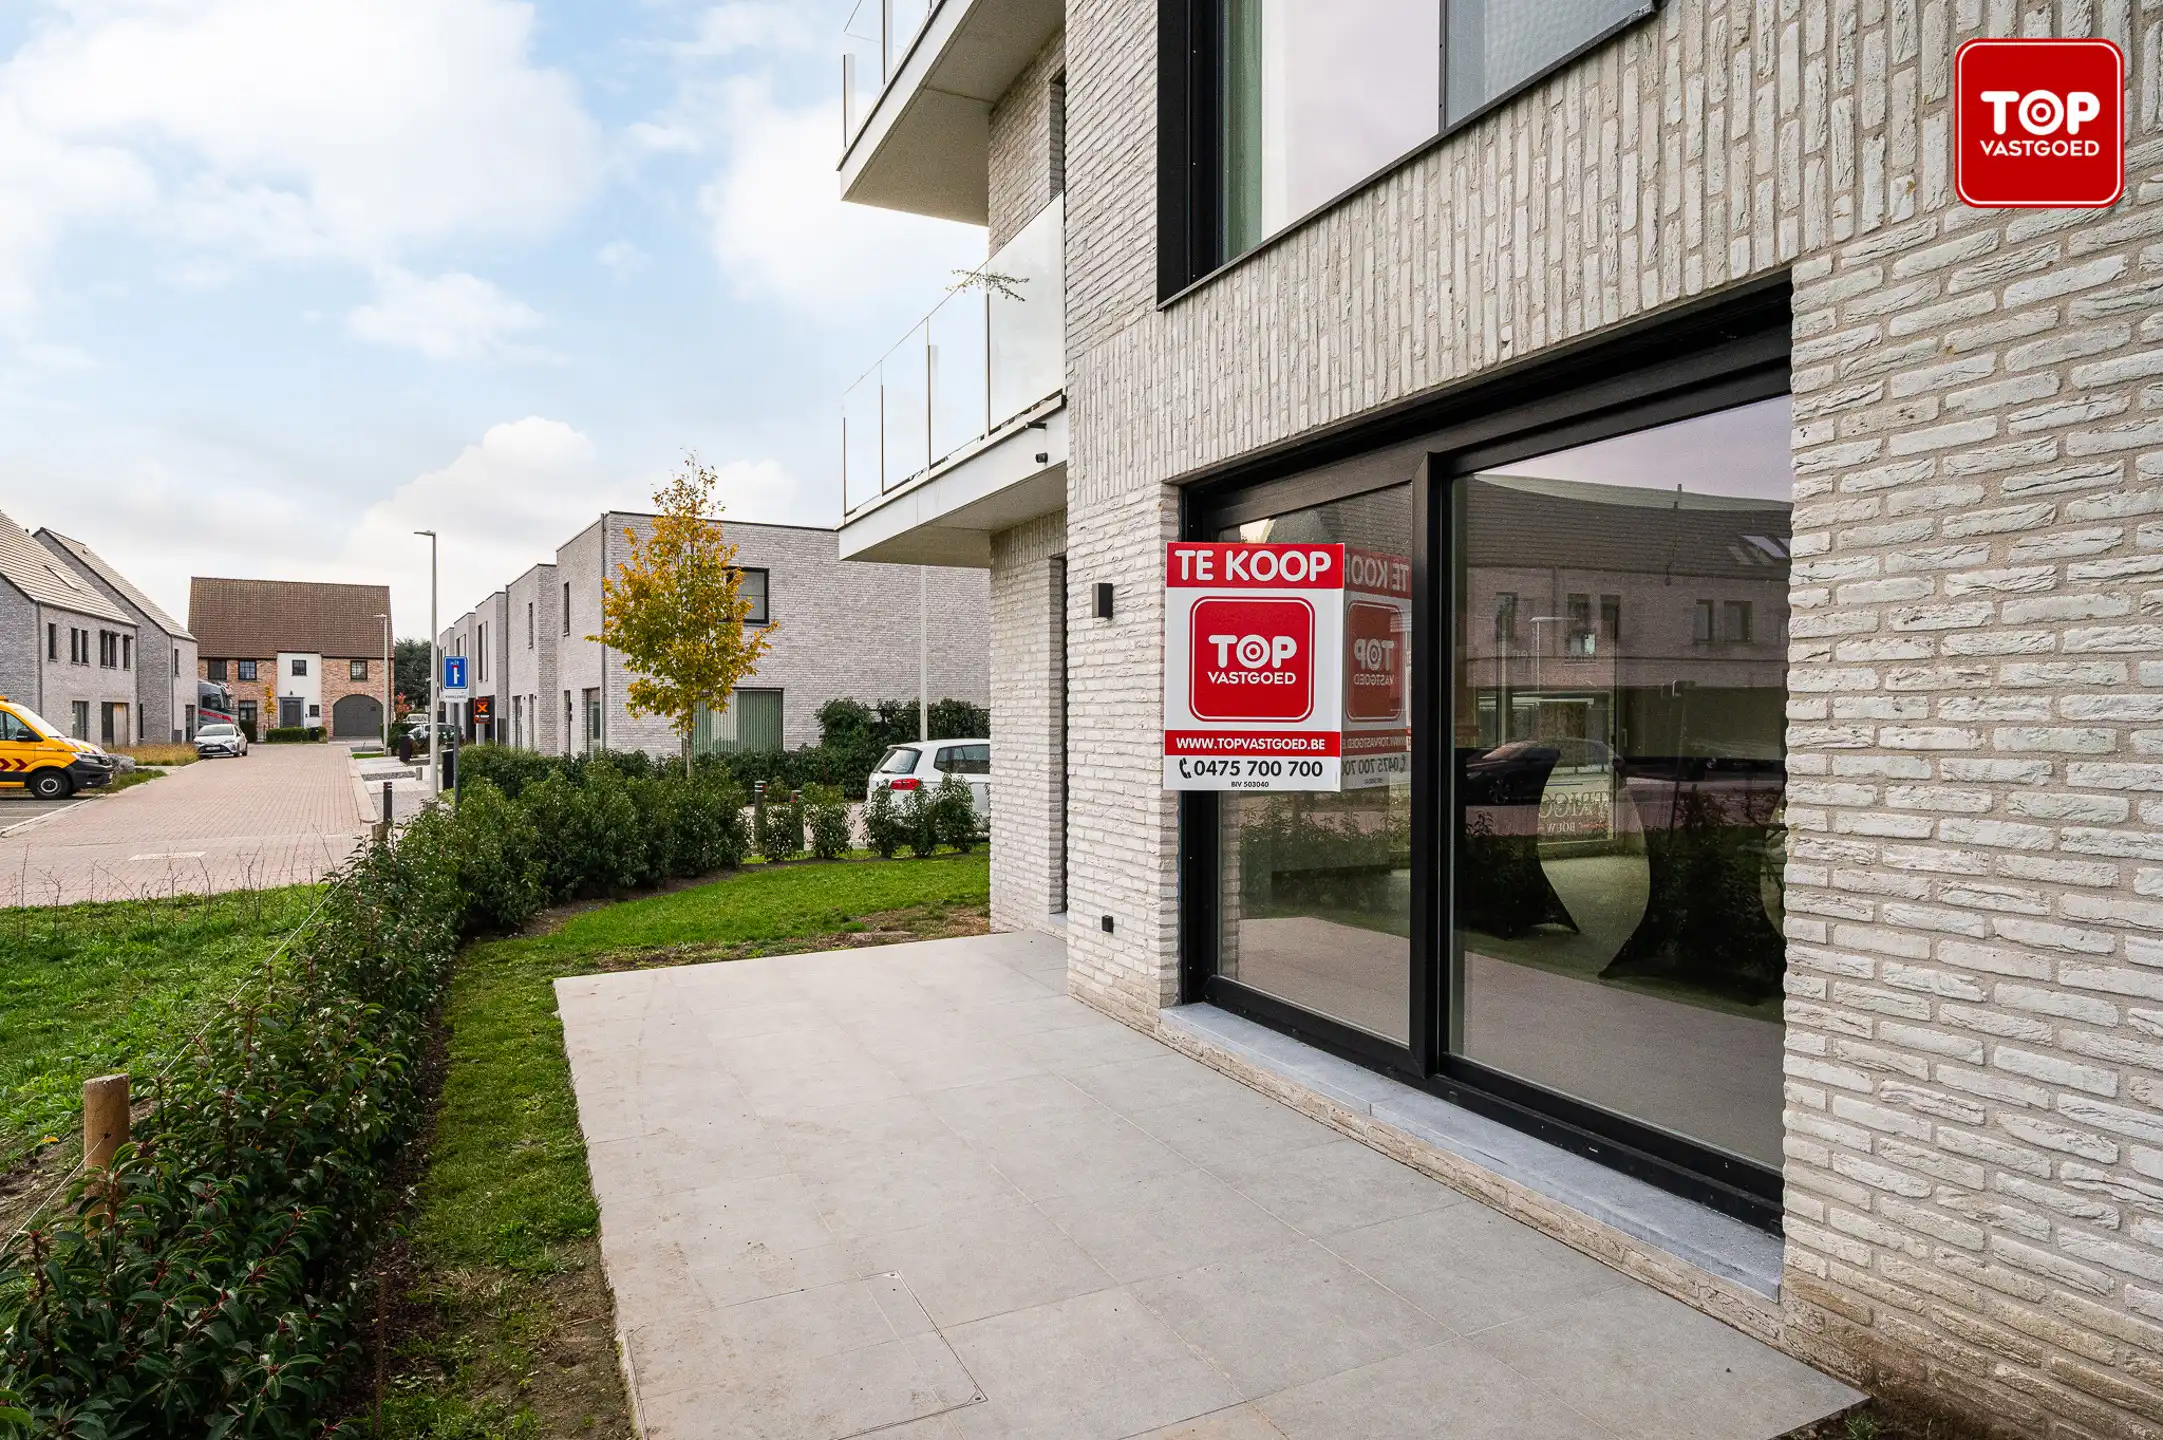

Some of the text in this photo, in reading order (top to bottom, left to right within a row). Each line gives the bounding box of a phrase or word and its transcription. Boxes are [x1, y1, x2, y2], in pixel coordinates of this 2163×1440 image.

[1175, 550, 1331, 582] TE KOOP
[1208, 634, 1297, 669] TOP
[1207, 671, 1296, 685] VASTGOED
[1176, 737, 1325, 750] WWW.TOPVASTGOED.BE
[1194, 760, 1323, 777] 0475 700 700
